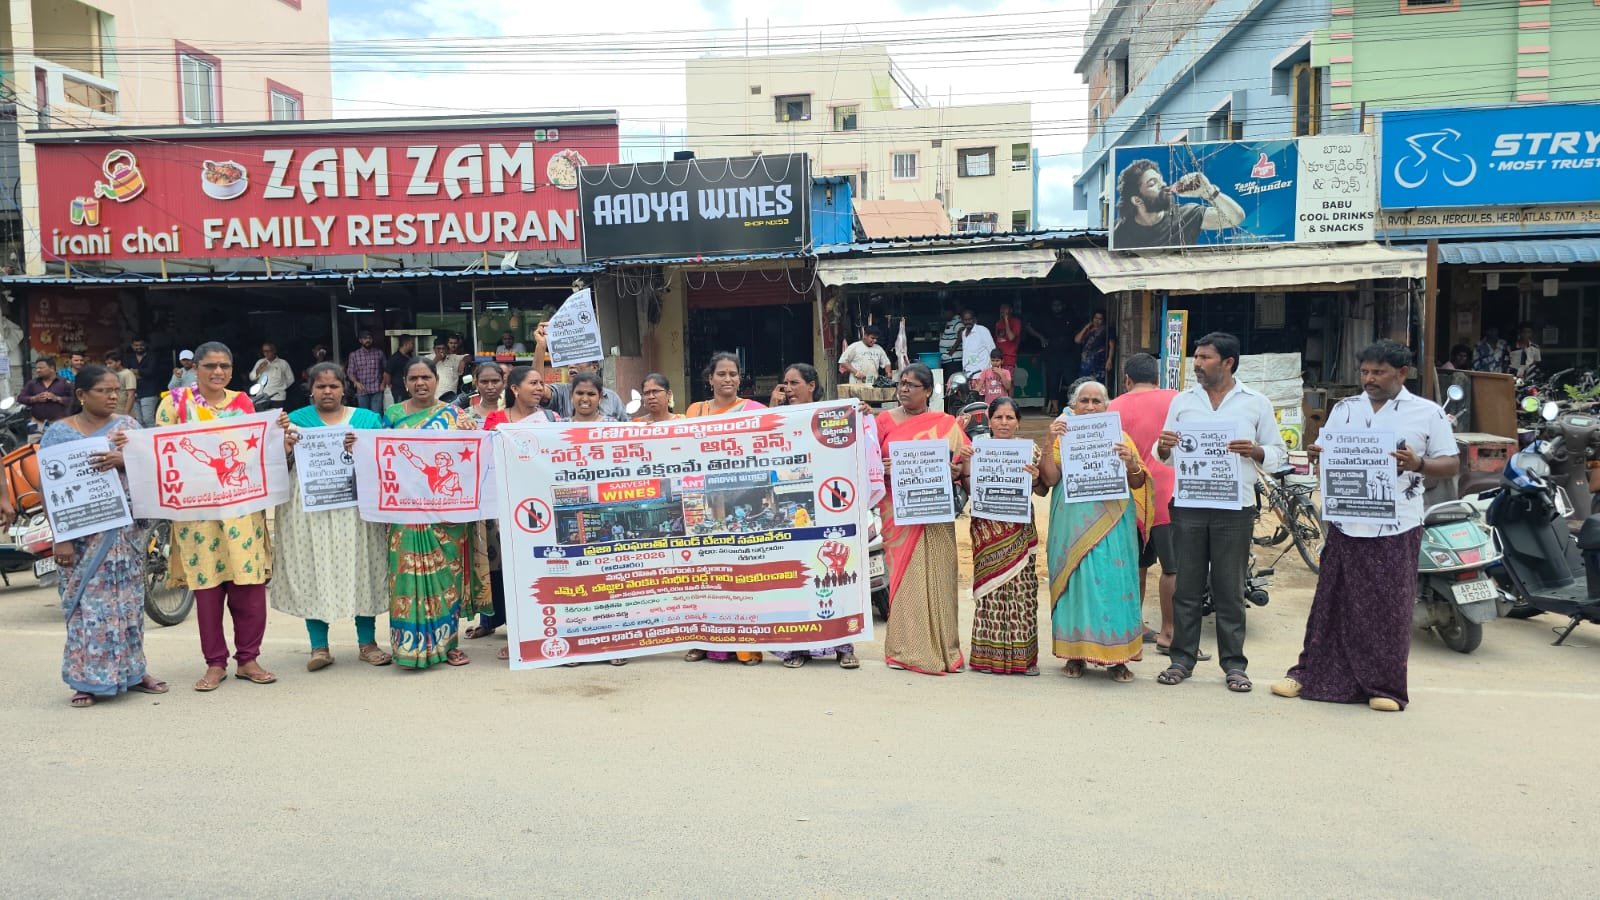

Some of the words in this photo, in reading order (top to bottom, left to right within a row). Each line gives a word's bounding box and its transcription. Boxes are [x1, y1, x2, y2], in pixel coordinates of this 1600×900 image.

[1323, 145, 1352, 154] బాబు
[1497, 160, 1547, 171] MOST
[263, 146, 390, 204] ZAM
[405, 142, 535, 201] ZAM
[1235, 181, 1257, 190] Taste
[1247, 180, 1293, 194] Thunder
[1312, 178, 1324, 190] &
[1331, 176, 1361, 193] స్నాక్స్
[593, 190, 689, 226] AADYA
[698, 184, 793, 220] WINES
[1322, 200, 1352, 209] BABU
[1300, 213, 1329, 221] COOL
[1333, 211, 1374, 220] DRINKS
[1555, 211, 1576, 221] TATA
[202, 213, 336, 250] FAMILY
[347, 208, 579, 248] RESTAURAN
[744, 220, 764, 228] SHOP
[1319, 223, 1364, 233] SNACKS
[52, 227, 111, 256] irani
[120, 225, 180, 254] chai
[612, 442, 653, 464] వైన్స్
[162, 441, 184, 506] AIDWA
[382, 444, 399, 506] AIDWA
[554, 466, 631, 482] షాపులను
[636, 459, 701, 479] తక్షణమే
[609, 480, 650, 490] SARVESH
[602, 487, 657, 501] WINES
[773, 623, 823, 634] (AIDWA)
